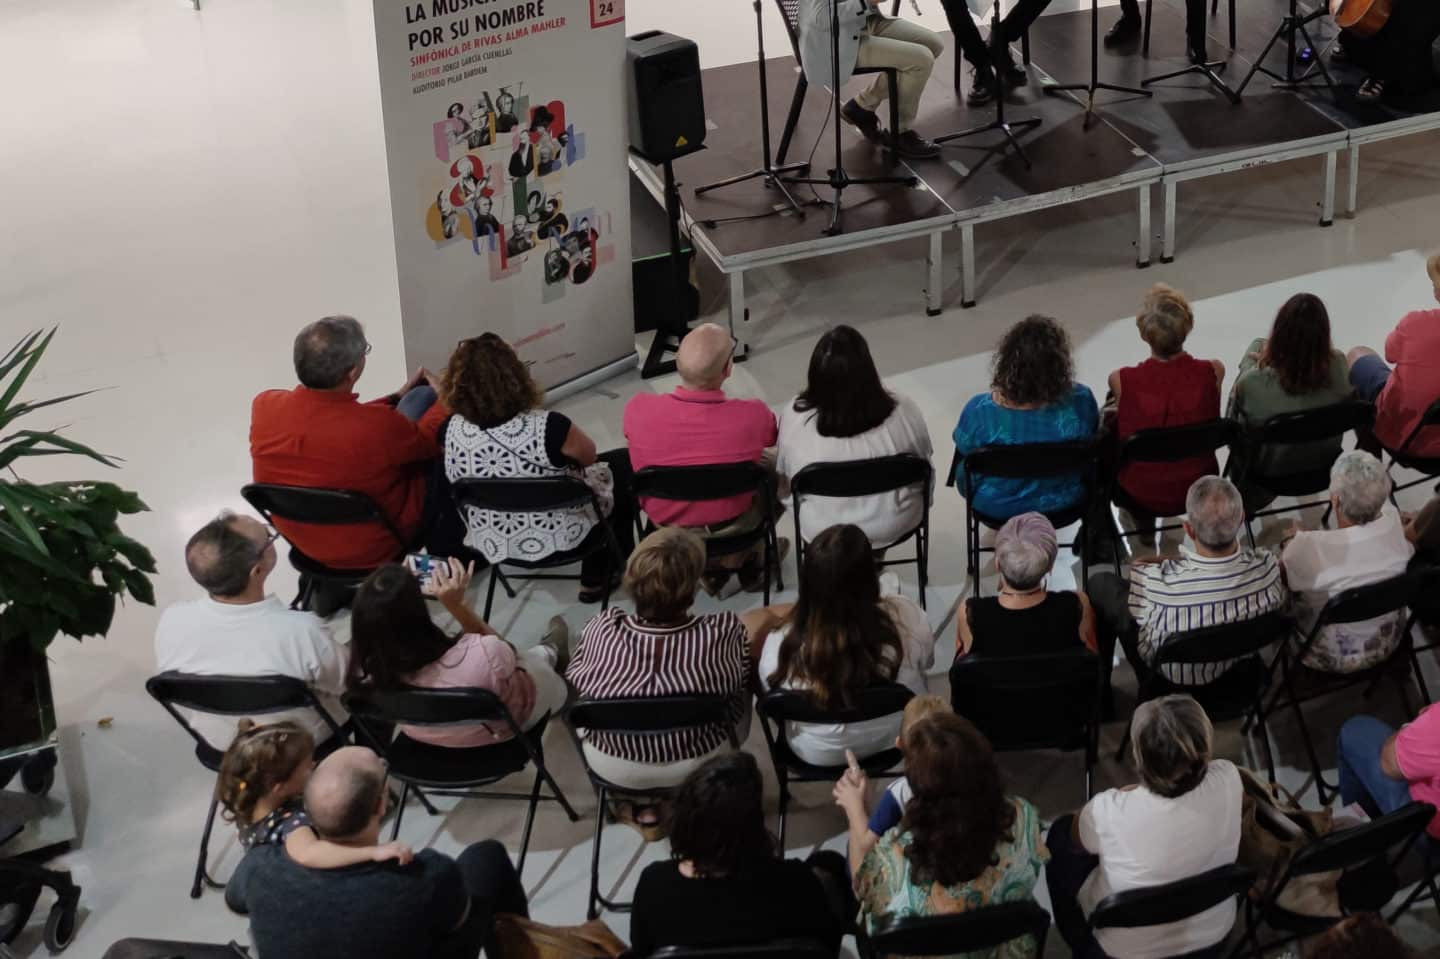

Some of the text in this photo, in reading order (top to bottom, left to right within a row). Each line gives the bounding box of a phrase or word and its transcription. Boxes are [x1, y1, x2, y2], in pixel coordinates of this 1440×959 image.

[405, 3, 426, 24] LA
[599, 2, 614, 17] 24
[408, 0, 545, 51] POR SU NOMBRE
[461, 42, 472, 53] DE
[473, 34, 503, 49] RIVAS
[505, 27, 529, 41] ALMA
[531, 17, 566, 33] MAHLER
